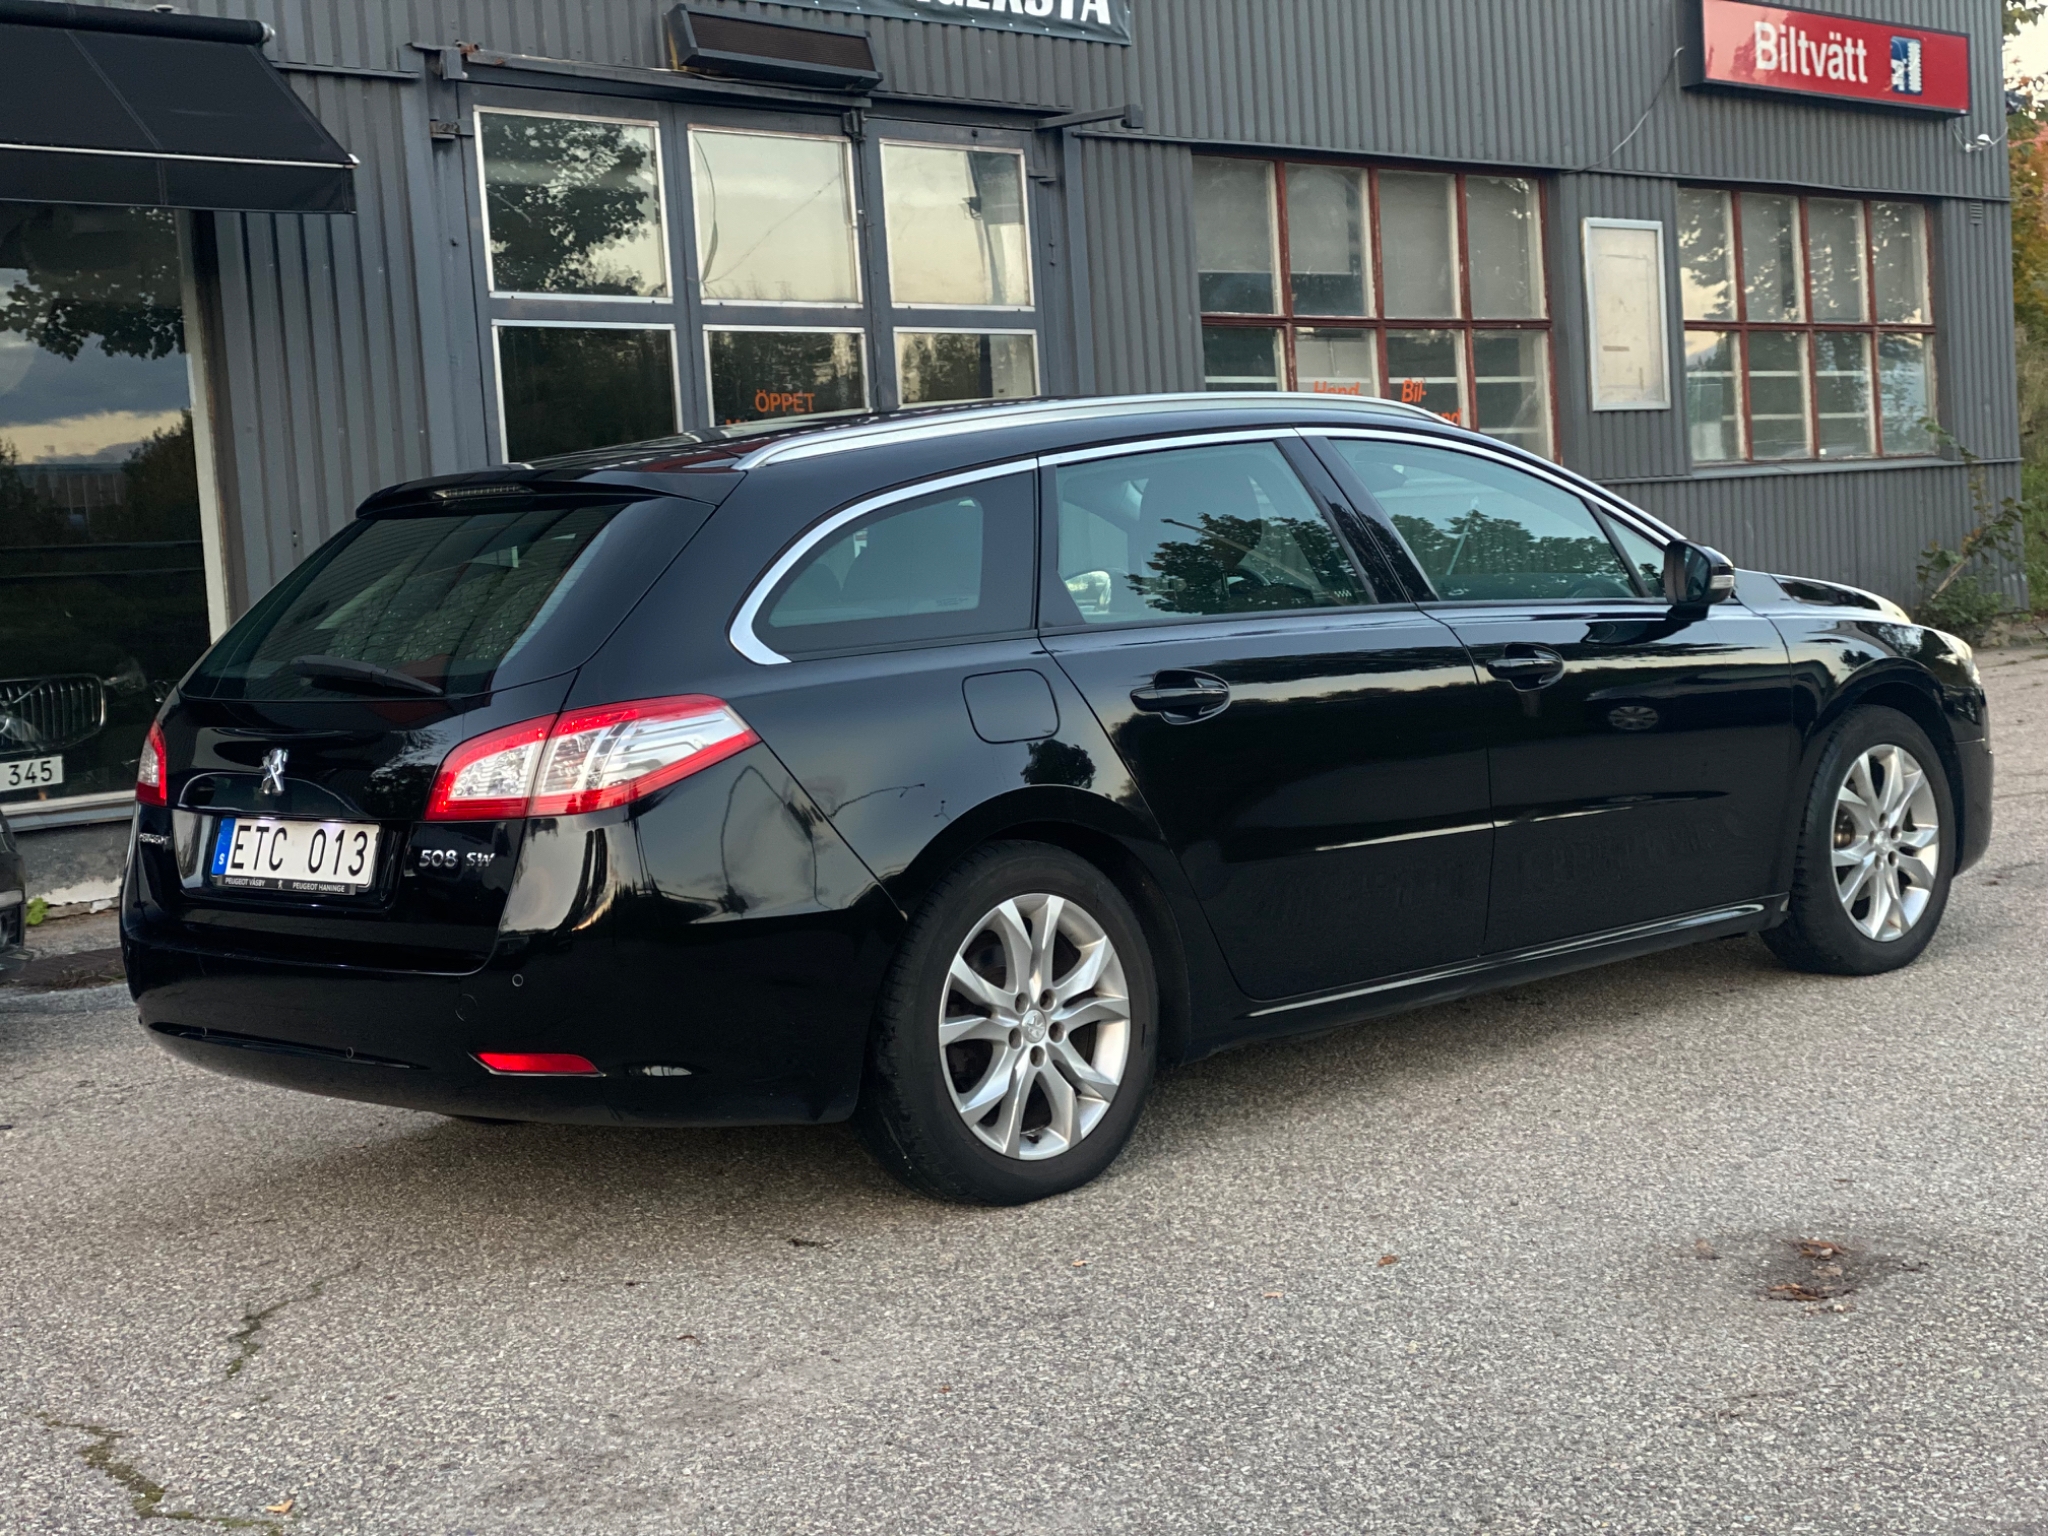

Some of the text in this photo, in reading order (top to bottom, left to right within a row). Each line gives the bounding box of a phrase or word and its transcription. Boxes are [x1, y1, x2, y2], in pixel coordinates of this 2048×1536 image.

[1754, 21, 1868, 83] Biltvätt
[754, 389, 816, 413] ÖPPET
[1401, 378, 1427, 403] Bil-
[8, 760, 53, 786] 345
[217, 824, 369, 877] S ETC 013
[418, 849, 496, 868] 508 SW
[225, 877, 249, 886] PEUGEOT
[292, 881, 346, 893] PEUGEOT HANINGE
